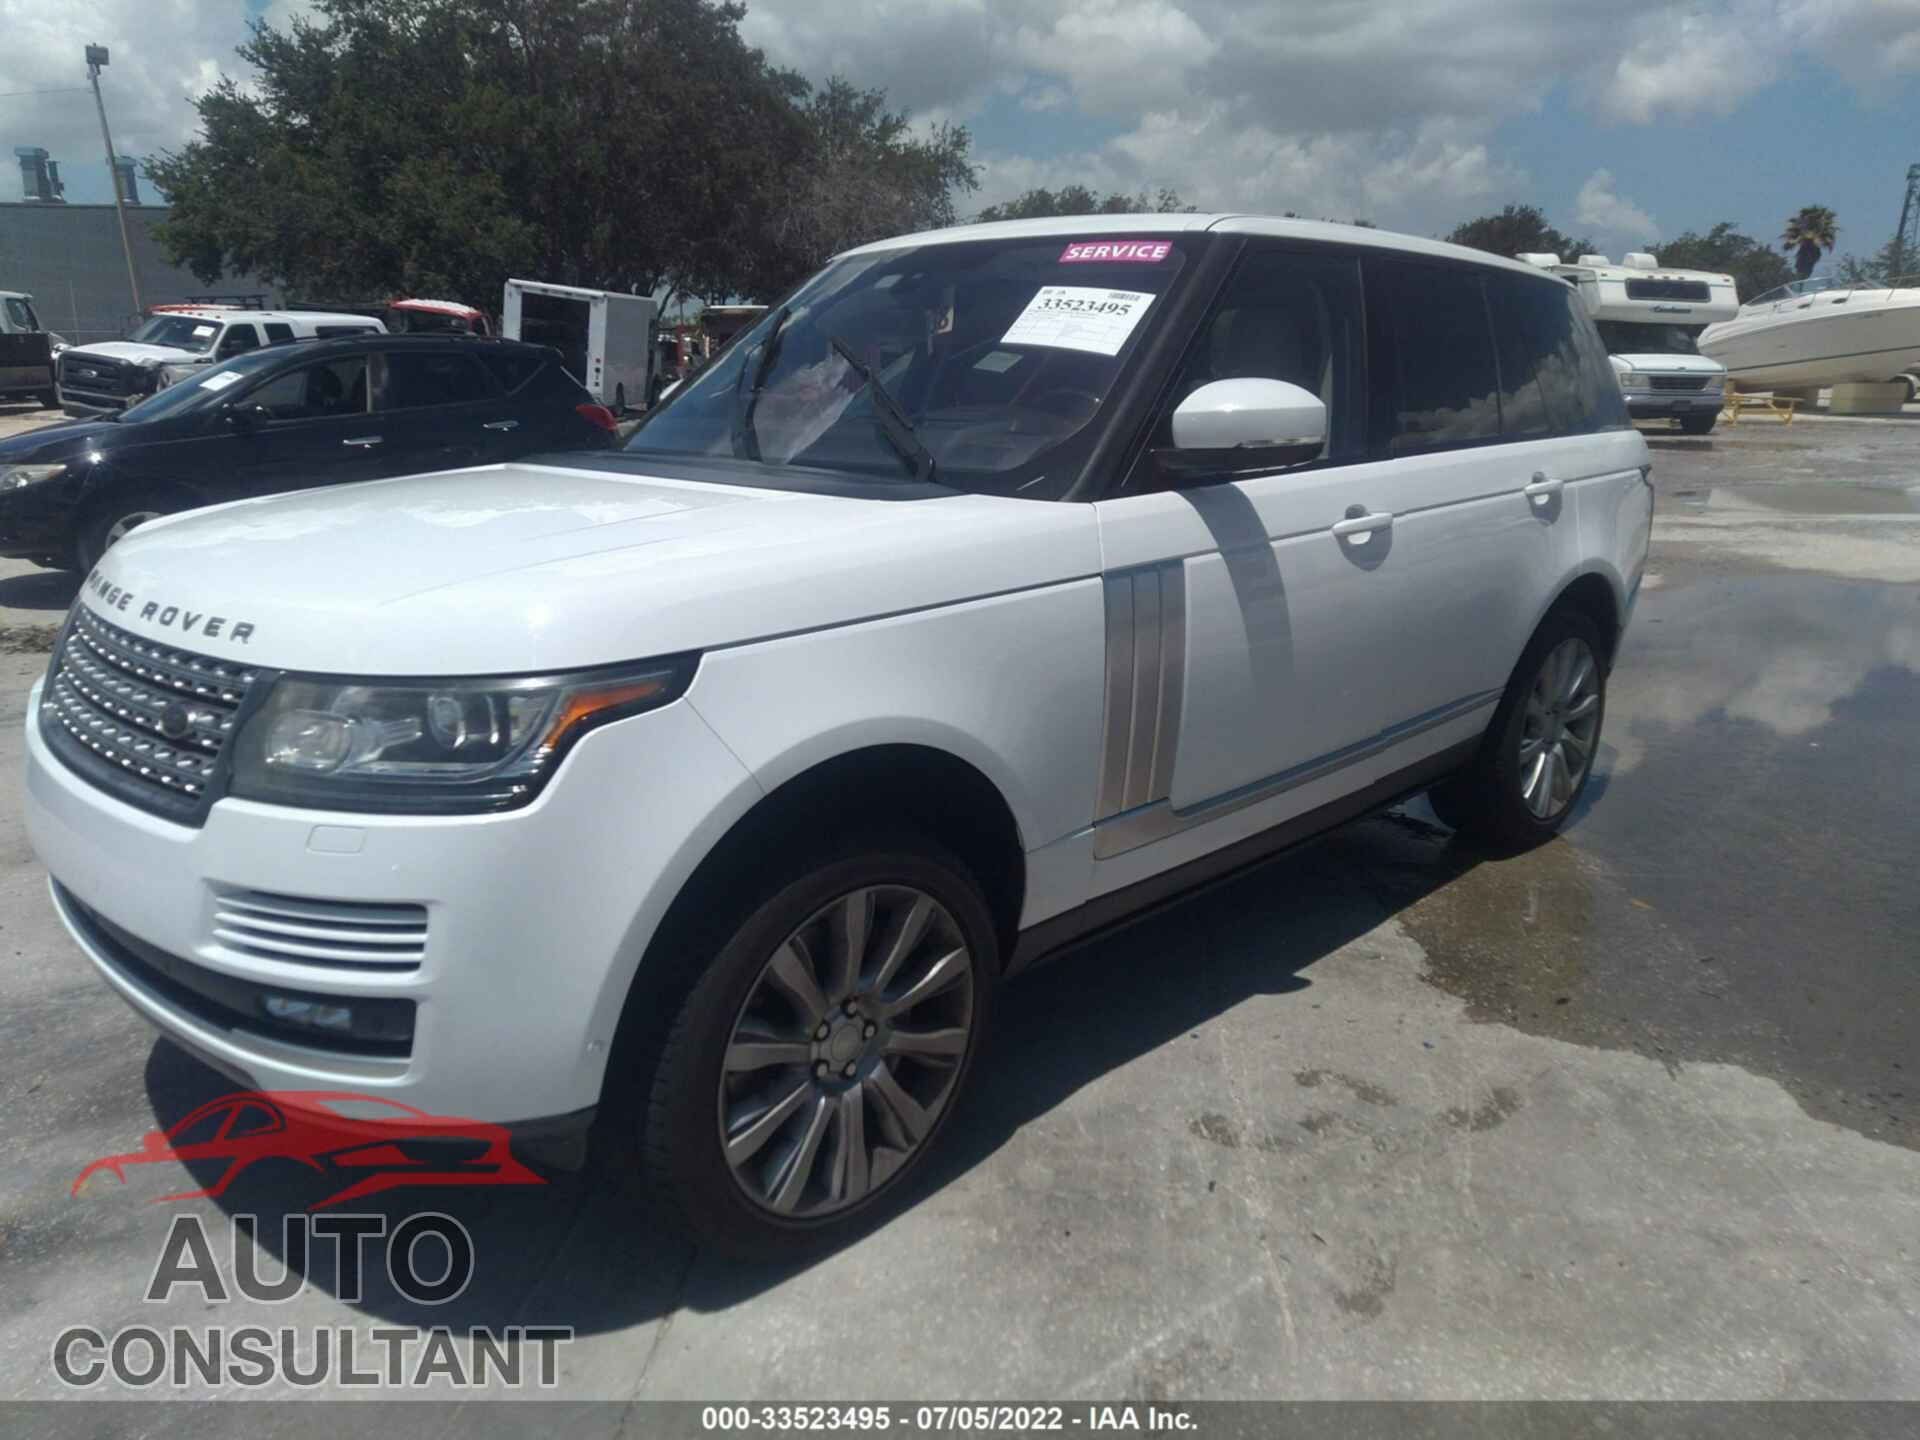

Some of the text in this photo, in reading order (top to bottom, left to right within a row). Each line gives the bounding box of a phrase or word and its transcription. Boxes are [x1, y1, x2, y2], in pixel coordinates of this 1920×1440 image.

[1066, 244, 1168, 259] SERVICE
[1037, 298, 1131, 316] 33523495
[139, 600, 255, 644] ROVER
